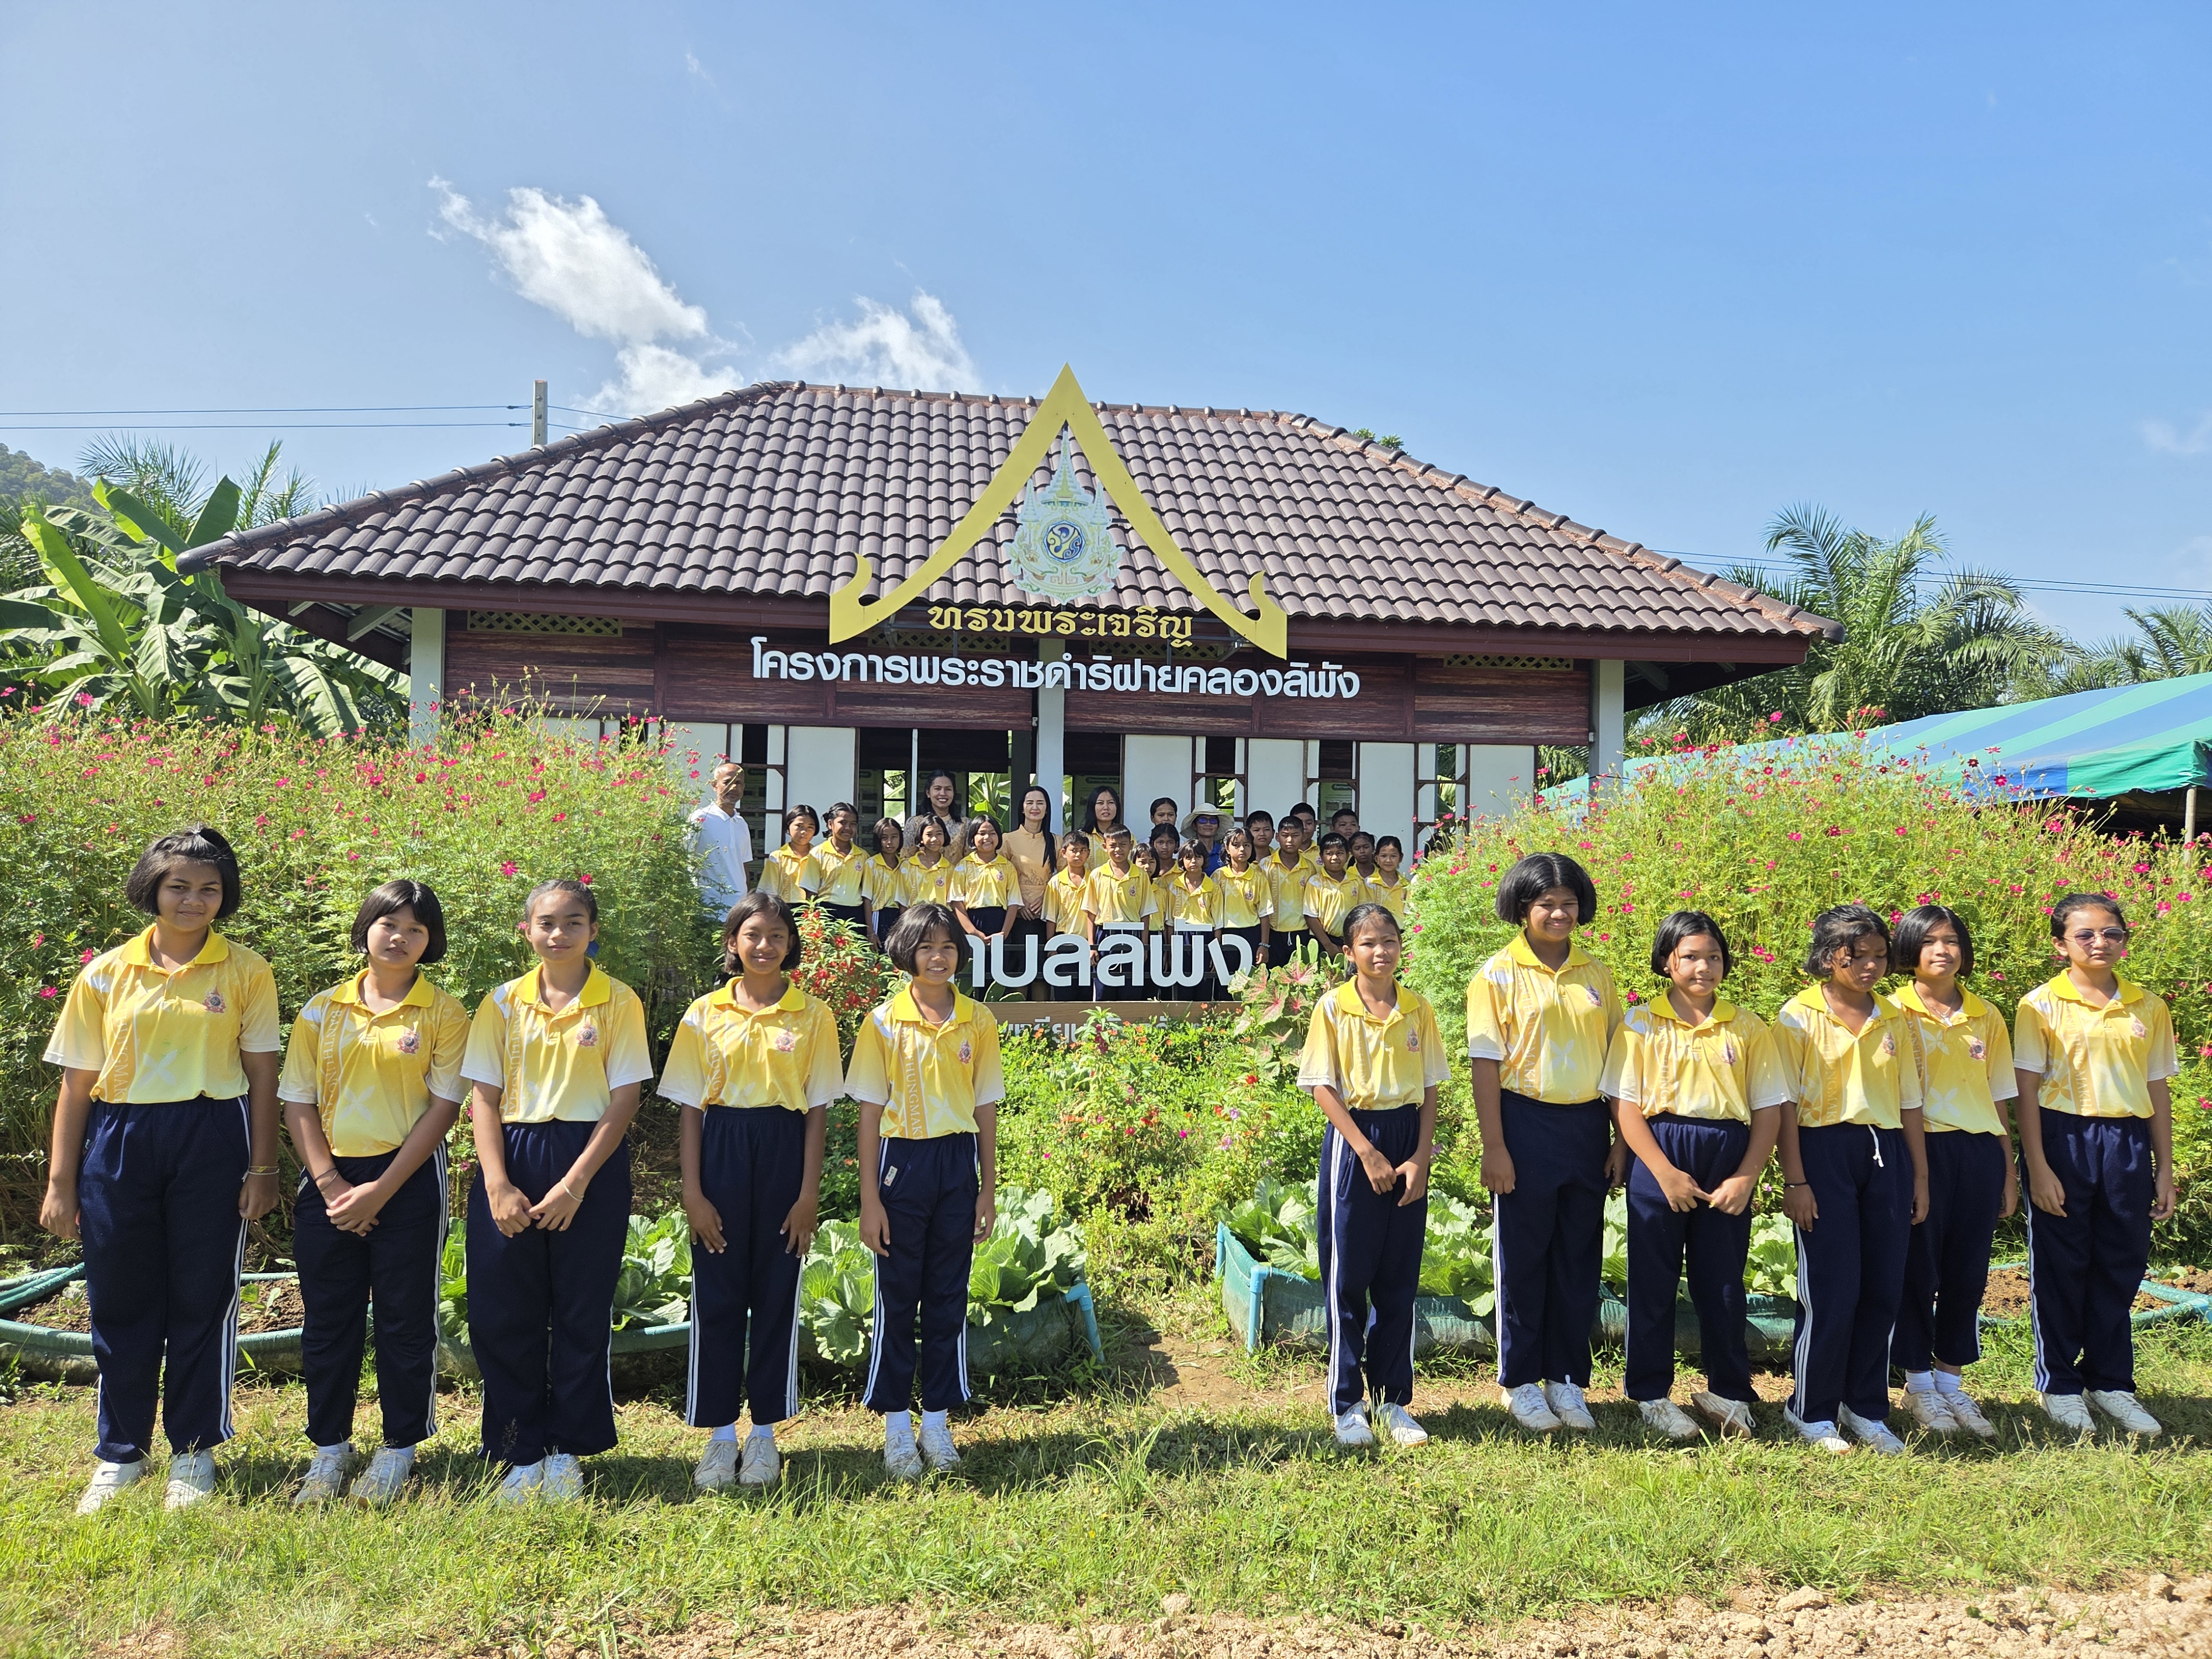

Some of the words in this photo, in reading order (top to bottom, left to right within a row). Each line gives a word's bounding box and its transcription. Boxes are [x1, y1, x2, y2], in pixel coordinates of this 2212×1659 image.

[927, 606, 1193, 648] ทรงพระเจริญ
